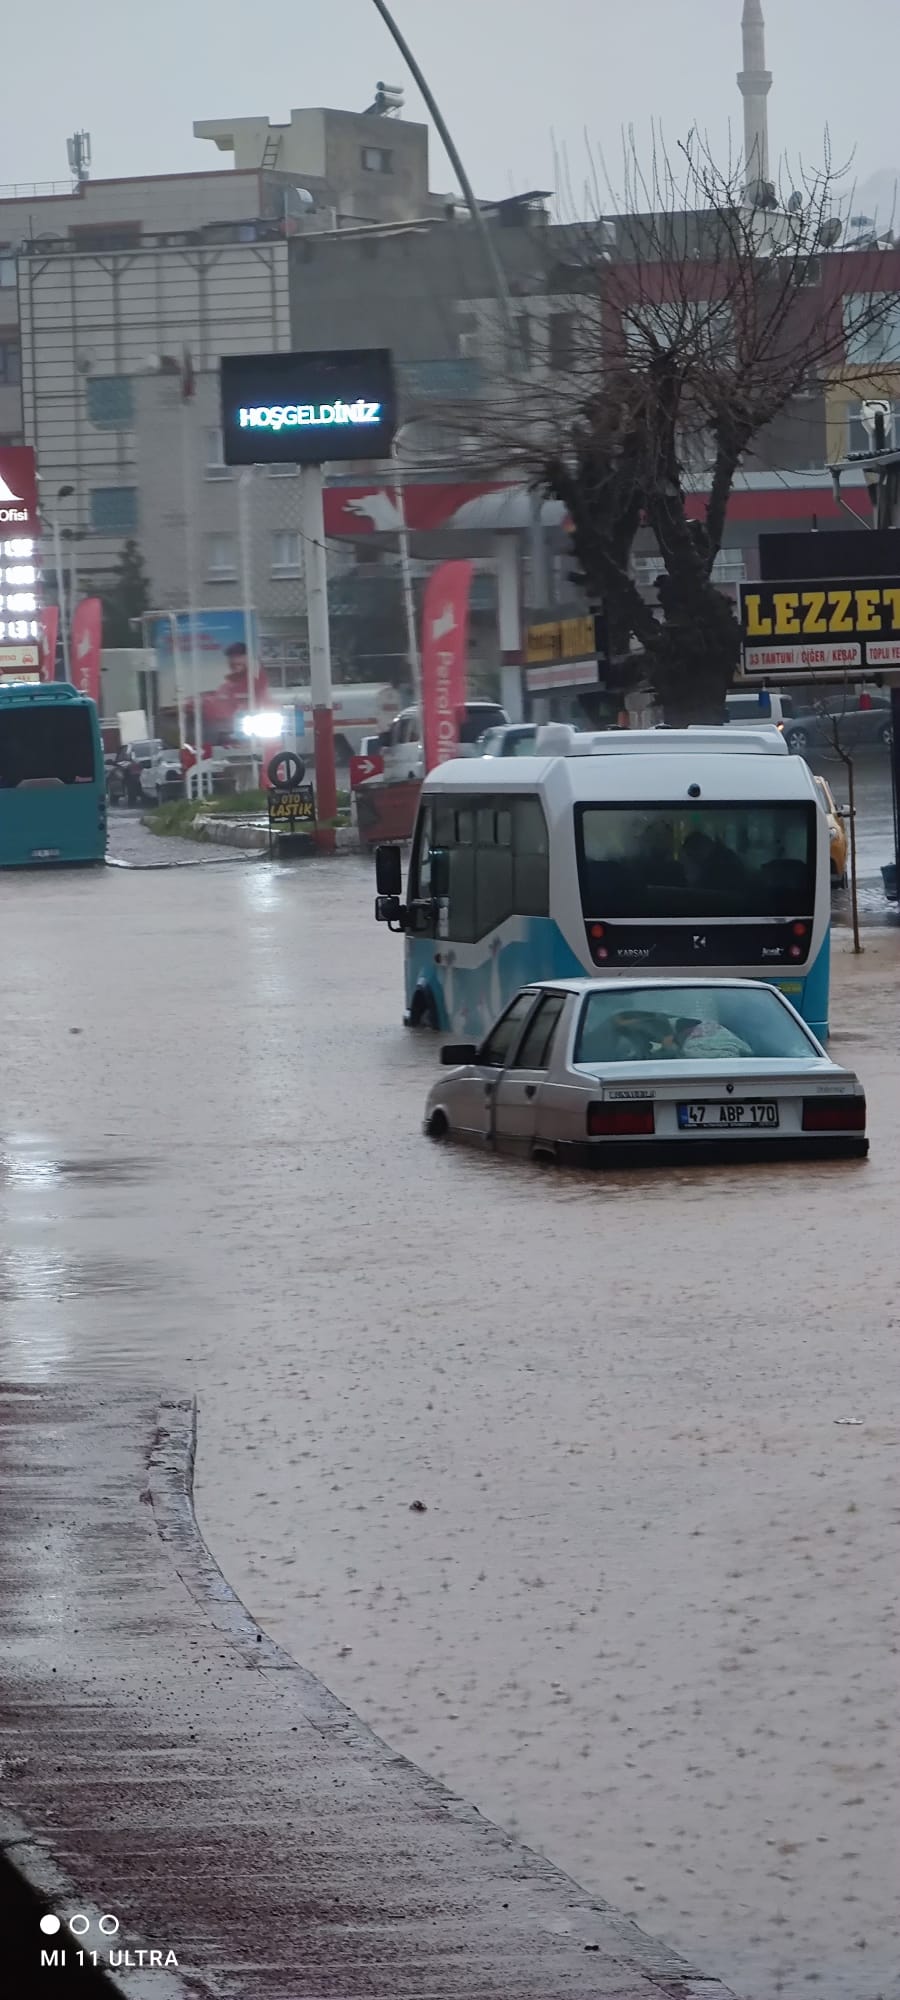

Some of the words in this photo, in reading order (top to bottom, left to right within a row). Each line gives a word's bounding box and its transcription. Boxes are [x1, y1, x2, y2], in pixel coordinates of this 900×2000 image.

[239, 399, 380, 430] HOŞGELDİNİZ
[0, 508, 28, 521] Ofisi
[744, 588, 900, 636] LEZZET
[832, 649, 858, 662] KEBAP
[869, 647, 889, 660] TOPLU
[436, 652, 454, 715] Petrol
[281, 794, 301, 804] OTO
[689, 1106, 705, 1122] 47
[720, 1105, 745, 1122] ABP
[750, 1105, 775, 1122] 170
